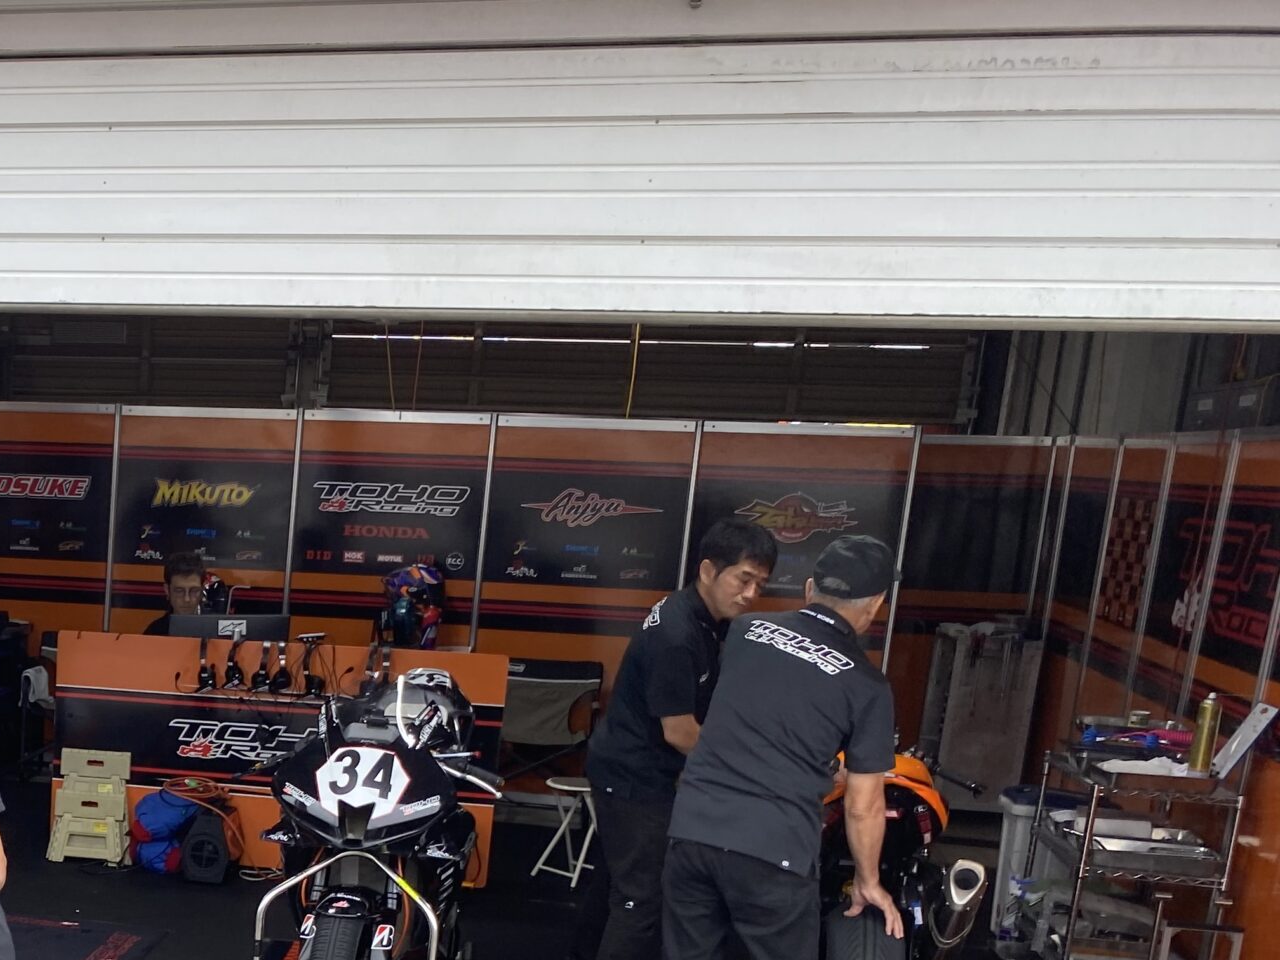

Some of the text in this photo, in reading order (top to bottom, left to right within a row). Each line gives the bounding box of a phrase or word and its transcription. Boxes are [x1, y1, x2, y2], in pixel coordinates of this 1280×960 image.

[313, 482, 470, 503] TOHO
[352, 500, 459, 517] Racing
[343, 525, 430, 539] HONDA
[750, 620, 855, 670] TOHO
[169, 719, 318, 747] TOH
[328, 749, 395, 800] 34
